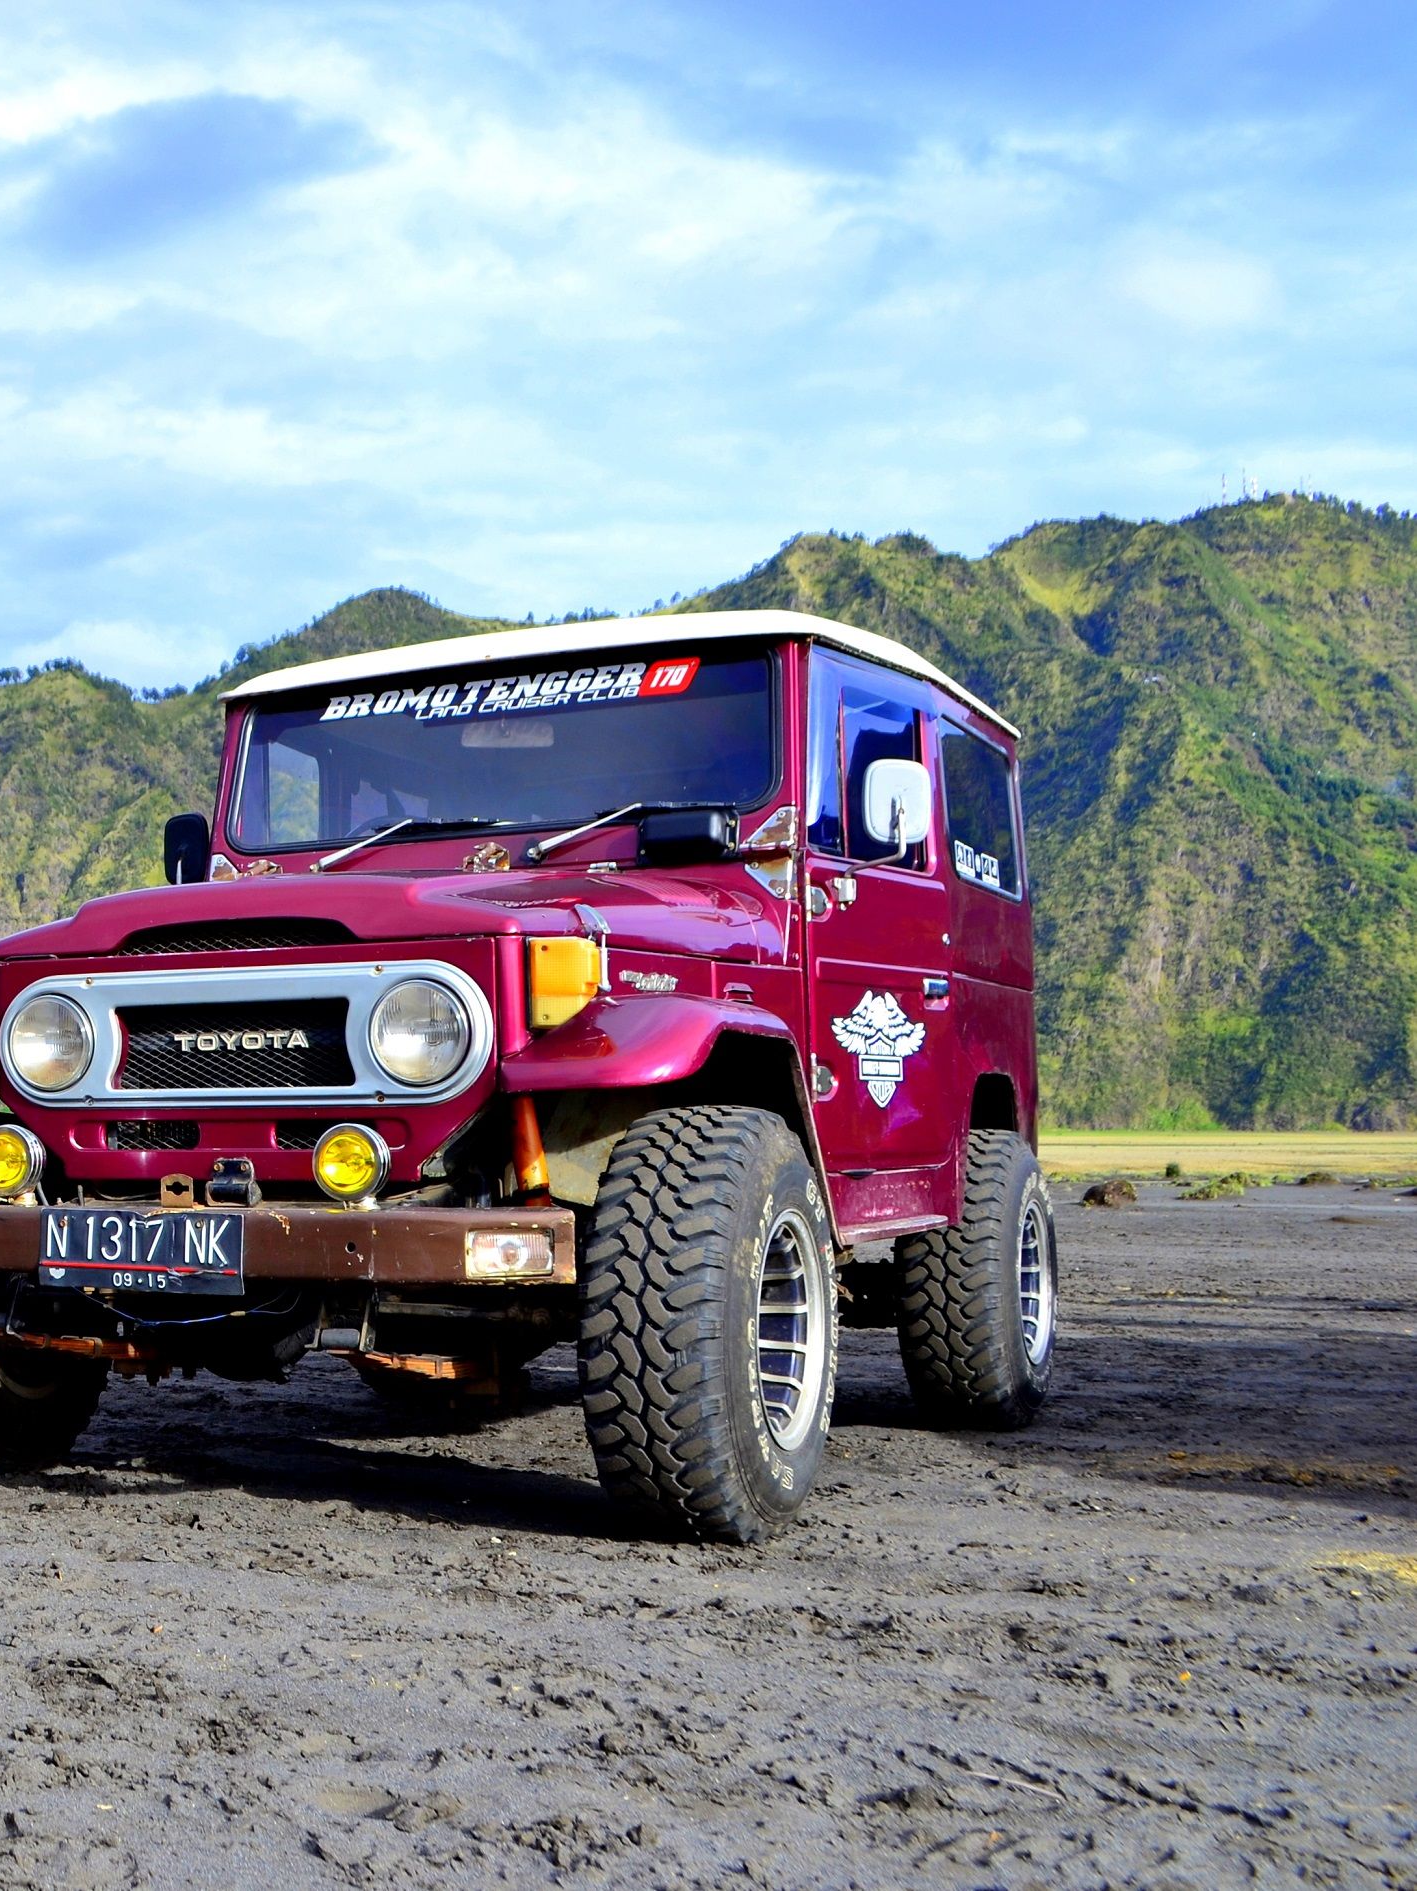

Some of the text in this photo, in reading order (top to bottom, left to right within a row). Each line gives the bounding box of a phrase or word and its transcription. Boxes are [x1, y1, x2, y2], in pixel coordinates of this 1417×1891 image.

[319, 683, 459, 721] BROMO
[461, 662, 647, 705] TENGGER
[415, 685, 640, 720] LAND CRUISER CLUB
[173, 1029, 310, 1052] TOYOTA
[806, 1178, 826, 1223] GT
[45, 1213, 231, 1267] N 1317 NK
